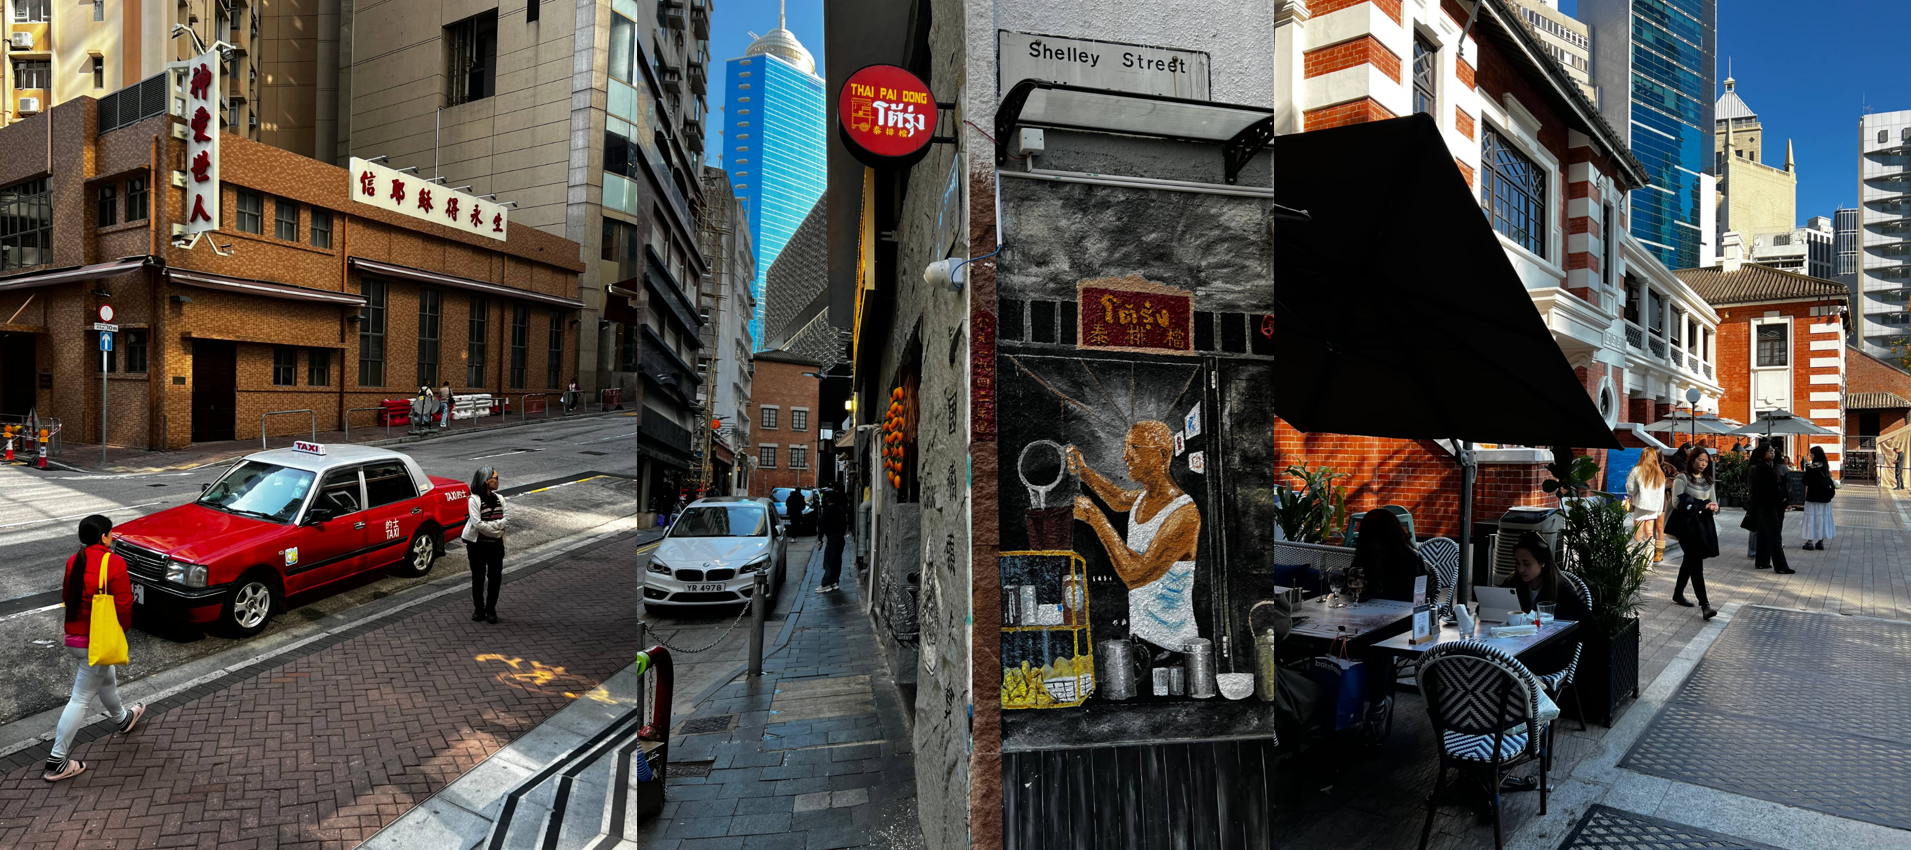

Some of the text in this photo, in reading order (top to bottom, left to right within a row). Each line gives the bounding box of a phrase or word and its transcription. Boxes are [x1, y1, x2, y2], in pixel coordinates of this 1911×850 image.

[1028, 41, 1186, 74] Shelley Street
[850, 83, 927, 104] THAI PAI DONG
[189, 62, 213, 223] 神愛世人
[296, 441, 319, 453] TAXI
[444, 489, 467, 502] TAXI 的士
[385, 518, 399, 530] 的士
[385, 527, 400, 540] TAXI
[686, 584, 722, 592] YR 4978
